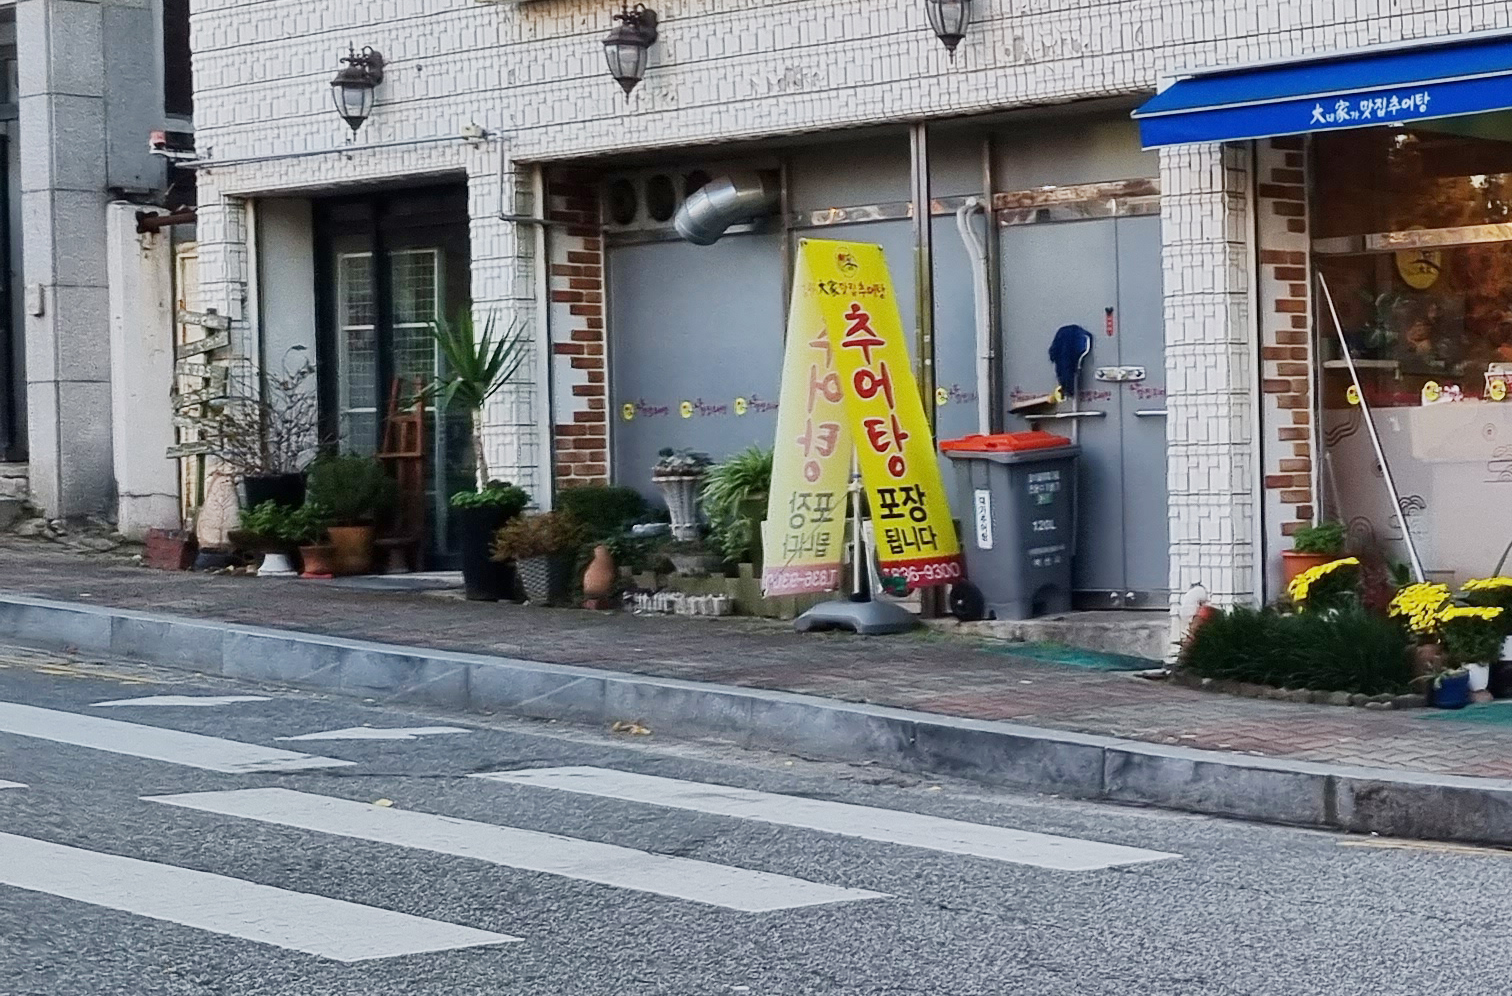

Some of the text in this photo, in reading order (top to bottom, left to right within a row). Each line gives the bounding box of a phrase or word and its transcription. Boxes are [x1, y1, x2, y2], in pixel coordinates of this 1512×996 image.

[842, 302, 908, 477] 추어탕
[877, 484, 928, 523] 포장
[885, 525, 937, 555] 됩니다
